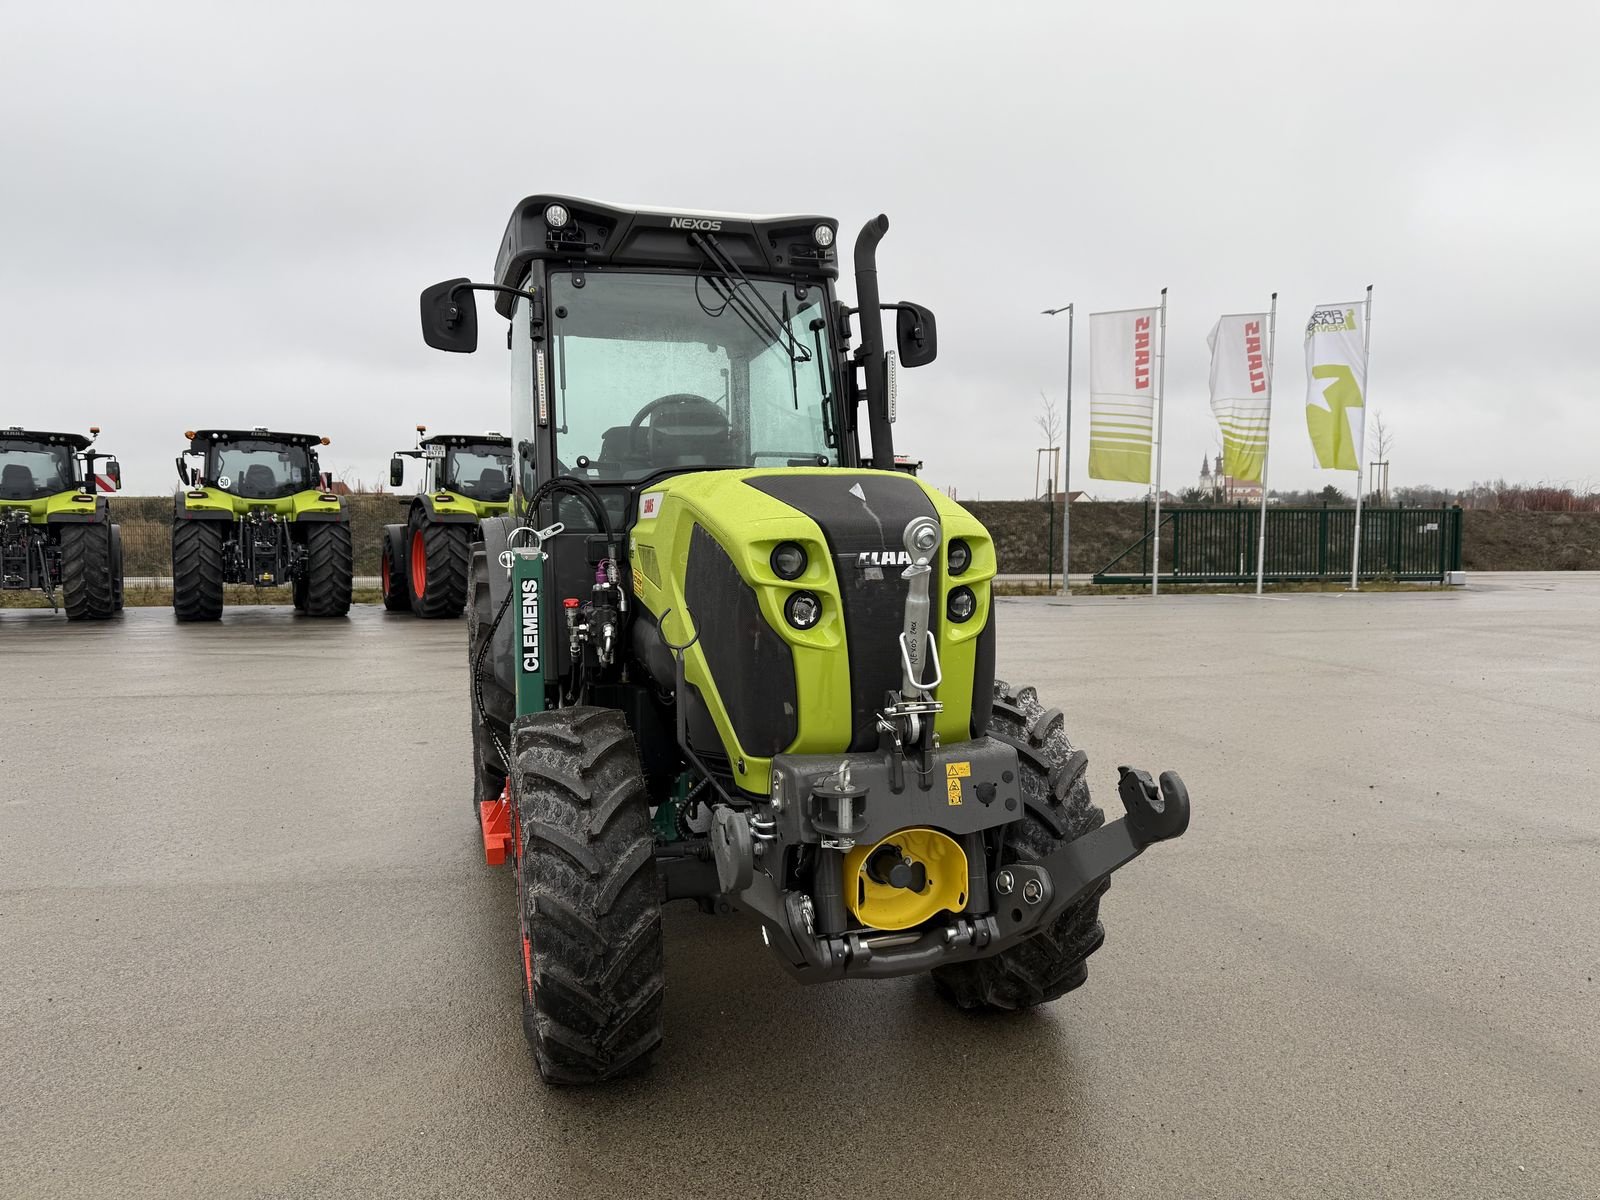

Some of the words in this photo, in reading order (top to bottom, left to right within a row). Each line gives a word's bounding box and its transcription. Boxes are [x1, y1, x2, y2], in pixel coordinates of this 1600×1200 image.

[670, 217, 722, 231] NEXOS
[220, 478, 229, 487] 50
[858, 551, 913, 566] CLAA
[521, 579, 540, 672] CLEMENS
